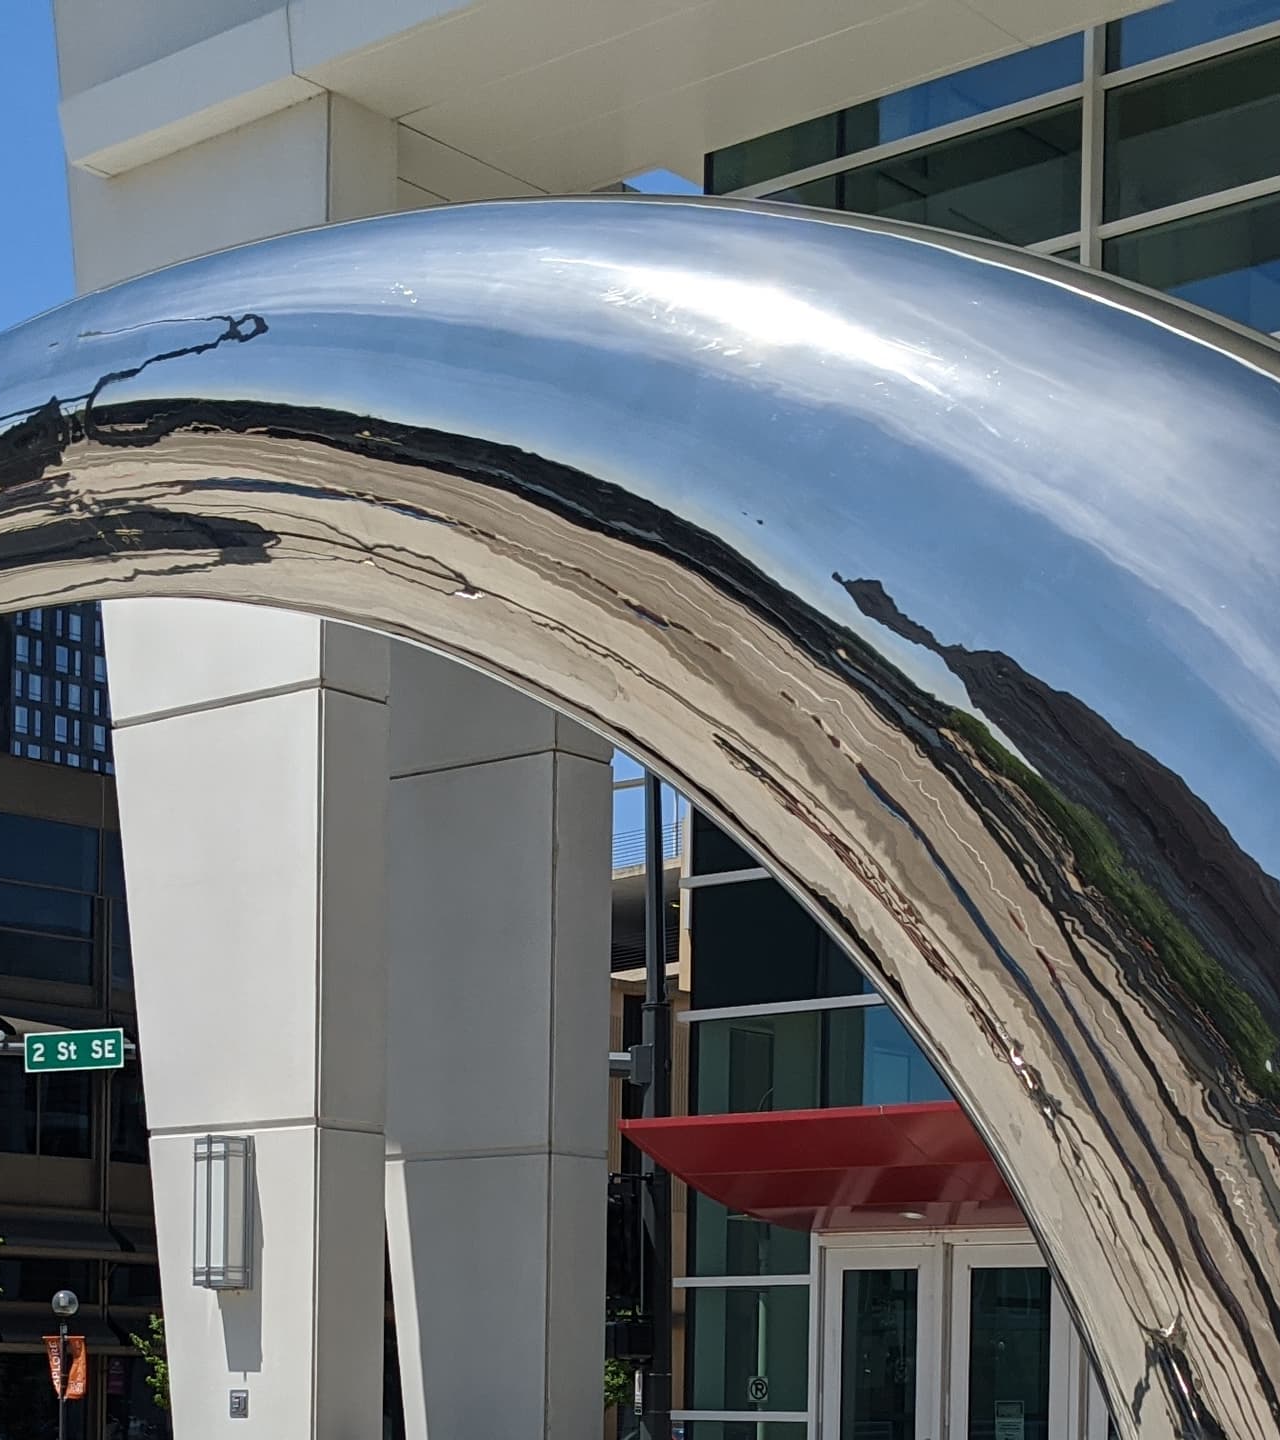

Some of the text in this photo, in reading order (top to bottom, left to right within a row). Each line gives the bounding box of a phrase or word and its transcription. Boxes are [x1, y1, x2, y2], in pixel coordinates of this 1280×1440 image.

[32, 1039, 116, 1062] 2 St SE
